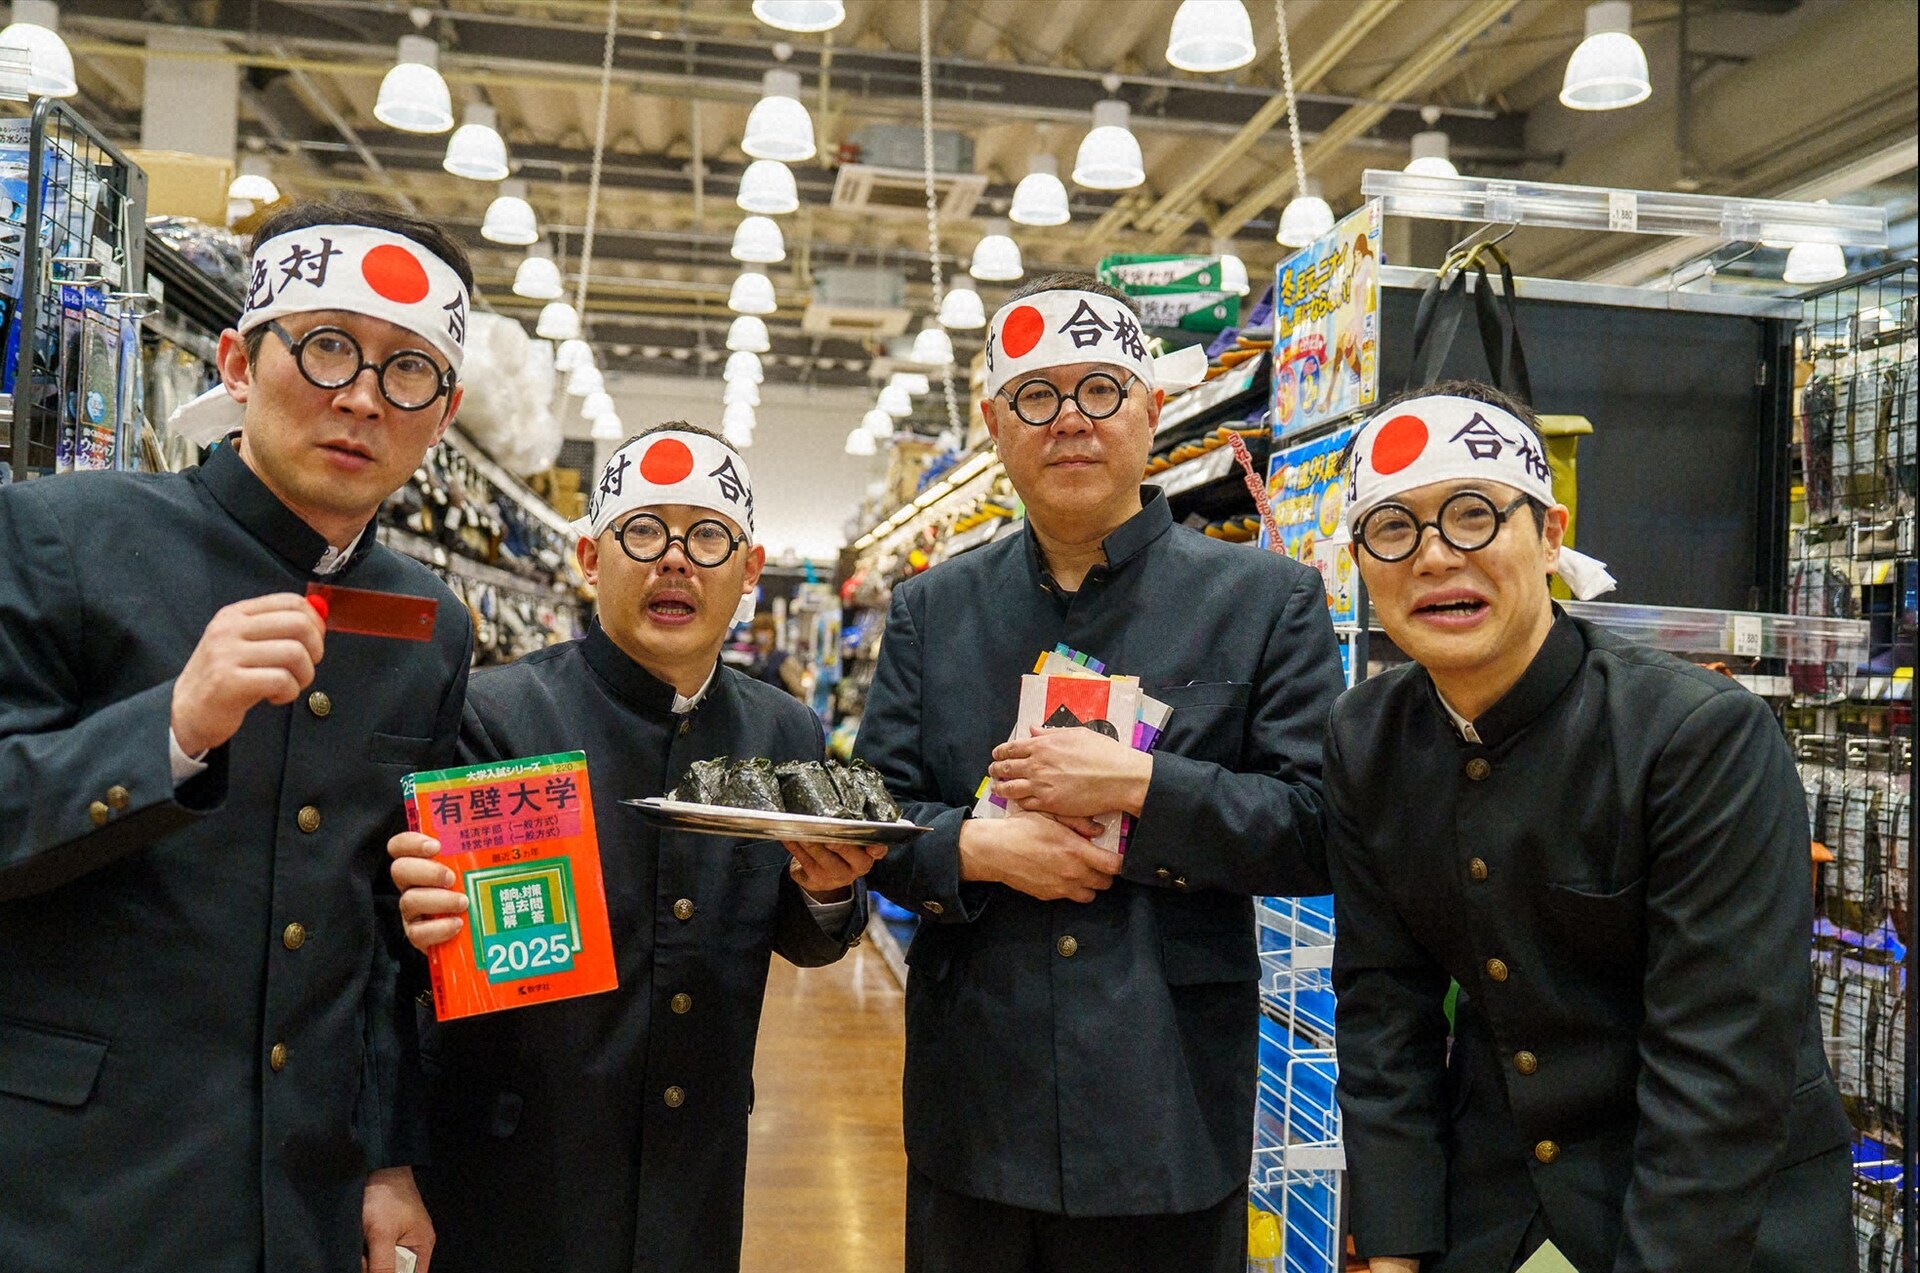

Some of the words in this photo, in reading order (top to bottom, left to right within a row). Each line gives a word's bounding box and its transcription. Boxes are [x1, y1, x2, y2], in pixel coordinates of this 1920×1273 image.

[246, 237, 343, 312] 絶対
[1058, 299, 1147, 362] 合格
[1448, 411, 1549, 483] 合格
[588, 454, 632, 525] 対
[466, 761, 541, 782] 大学入試シリーズ
[555, 763, 573, 773] 220
[432, 777, 577, 825] 有壁大学
[460, 824, 502, 839] 経済学部
[461, 834, 504, 851] 経営学部
[501, 896, 544, 915] 過去問
[487, 934, 570, 974] 2025
